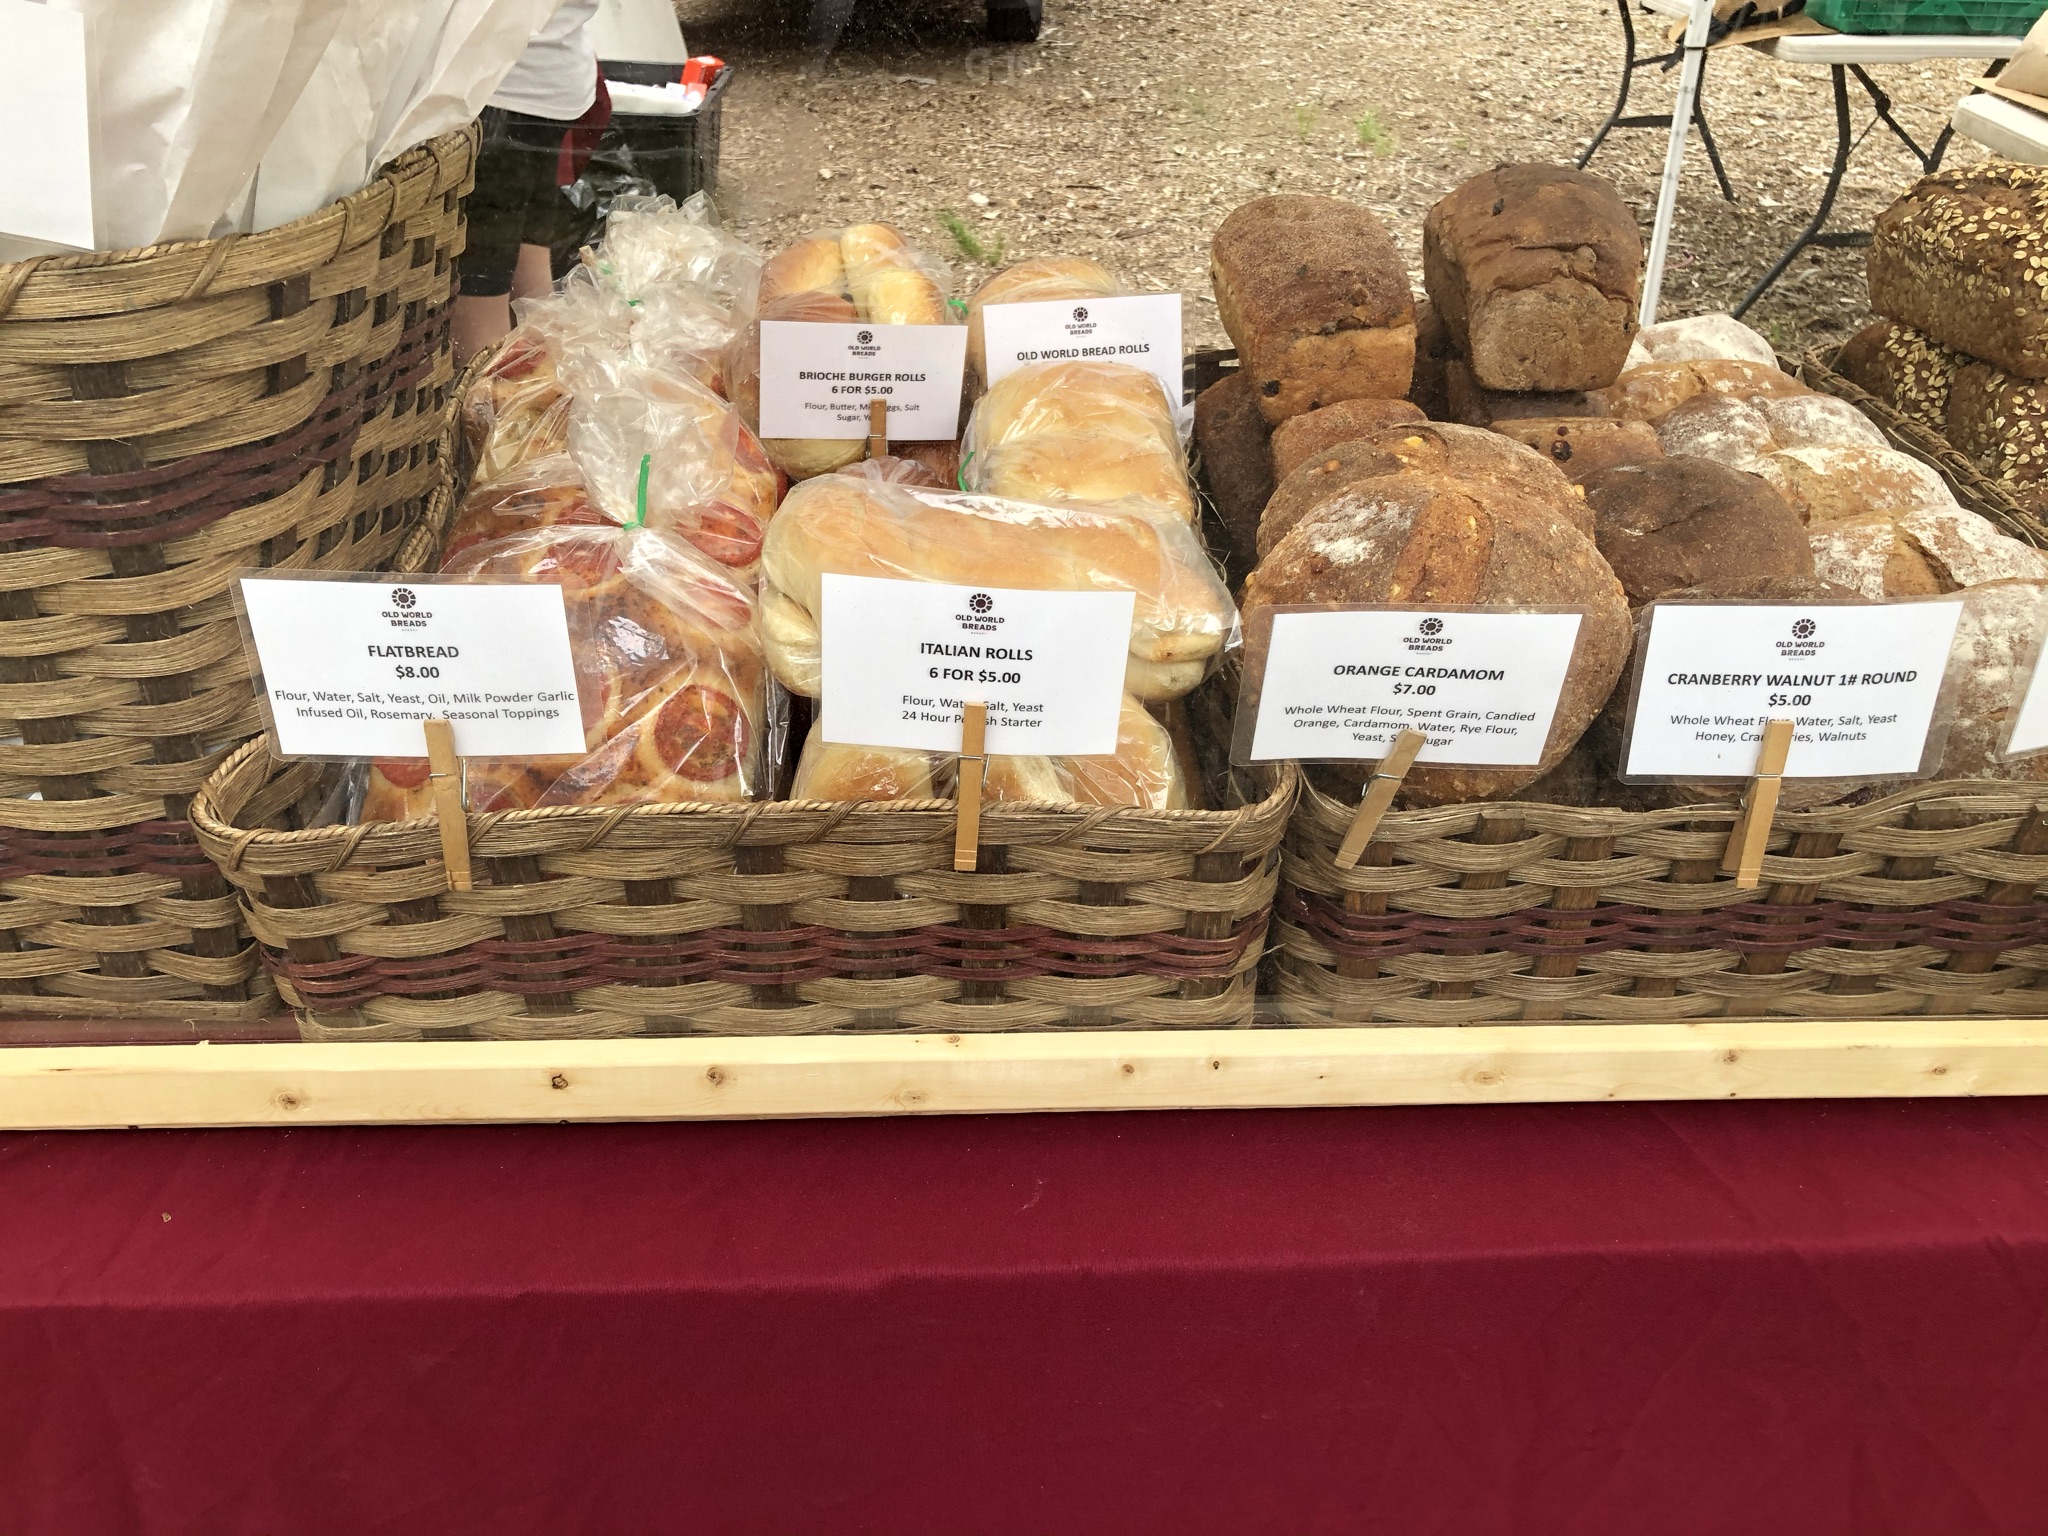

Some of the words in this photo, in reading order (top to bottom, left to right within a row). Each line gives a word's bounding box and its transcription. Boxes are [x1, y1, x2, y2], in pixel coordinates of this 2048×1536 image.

[1016, 351, 1038, 361] OLD
[1041, 348, 1079, 359] WORLD
[1082, 346, 1116, 357] BREAD
[1119, 343, 1150, 354] ROLLS
[799, 371, 846, 381] BRIOCHE
[849, 373, 892, 381] BURGER
[894, 373, 926, 382] ROLLS
[831, 385, 838, 394] 6
[841, 386, 862, 394] FOR
[864, 386, 893, 395] $5.00
[804, 402, 828, 412] Flour,
[830, 403, 857, 412] Butter,
[904, 404, 920, 412] Salt
[837, 414, 862, 422] Sugar,
[401, 611, 433, 619] WORLD
[955, 614, 972, 622] OLD
[974, 615, 1005, 624] WORLD
[962, 622, 997, 631] BREADS
[367, 645, 459, 658] FLATBREAD
[920, 642, 980, 658] ITALIAN
[985, 647, 1033, 661] ROLLS
[395, 664, 440, 680] $8.00
[929, 667, 939, 679] 6
[943, 668, 974, 681] FOR
[978, 669, 1021, 684] $5.00
[1333, 665, 1401, 677] ORANGE
[1404, 667, 1505, 681] CARDAMOM
[1668, 673, 1762, 686] CRANBERRY
[1766, 674, 1836, 687] WALNUT
[1839, 674, 1857, 686] 1#
[1861, 670, 1917, 685] ROUND
[1392, 682, 1436, 696] $7.00
[275, 690, 310, 702] Flour,
[312, 691, 354, 703] Water,
[357, 692, 385, 704] Salt,
[387, 693, 425, 705] Yeast,
[428, 693, 450, 705] Oil,
[453, 693, 481, 704] Milk
[485, 692, 533, 703] Powder
[537, 691, 575, 702] Garlic
[902, 695, 936, 707] Flour,
[1012, 702, 1044, 713] Yeast
[1768, 693, 1812, 707] $5.00
[296, 707, 343, 718] Infused
[346, 708, 367, 720] Oil,
[442, 709, 499, 720] Seasonal
[501, 708, 560, 720] Toppings
[902, 710, 917, 720] 24
[920, 712, 951, 723] Hour
[1000, 717, 1043, 728] Starter
[1285, 705, 1323, 715] Whole
[1327, 705, 1366, 714] Wheat
[1370, 705, 1403, 717] Flour,
[1407, 708, 1442, 719] Spent
[1446, 710, 1481, 721] Grain,
[1486, 711, 1536, 721] Candied
[1670, 715, 1710, 725] Whole
[1714, 715, 1755, 726] Wheat
[1796, 716, 1834, 728] Water,
[1838, 714, 1863, 726] Salt,
[1868, 713, 1897, 724] Yeast
[1293, 719, 1340, 729] Orange,
[1418, 722, 1456, 734] Water,
[1460, 724, 1482, 735] Rye
[1485, 725, 1518, 736] Flour,
[1352, 732, 1386, 743] Yeast,
[1426, 738, 1453, 747] ugar
[1695, 731, 1736, 743] Honey,
[1818, 731, 1867, 742] Walnuts
